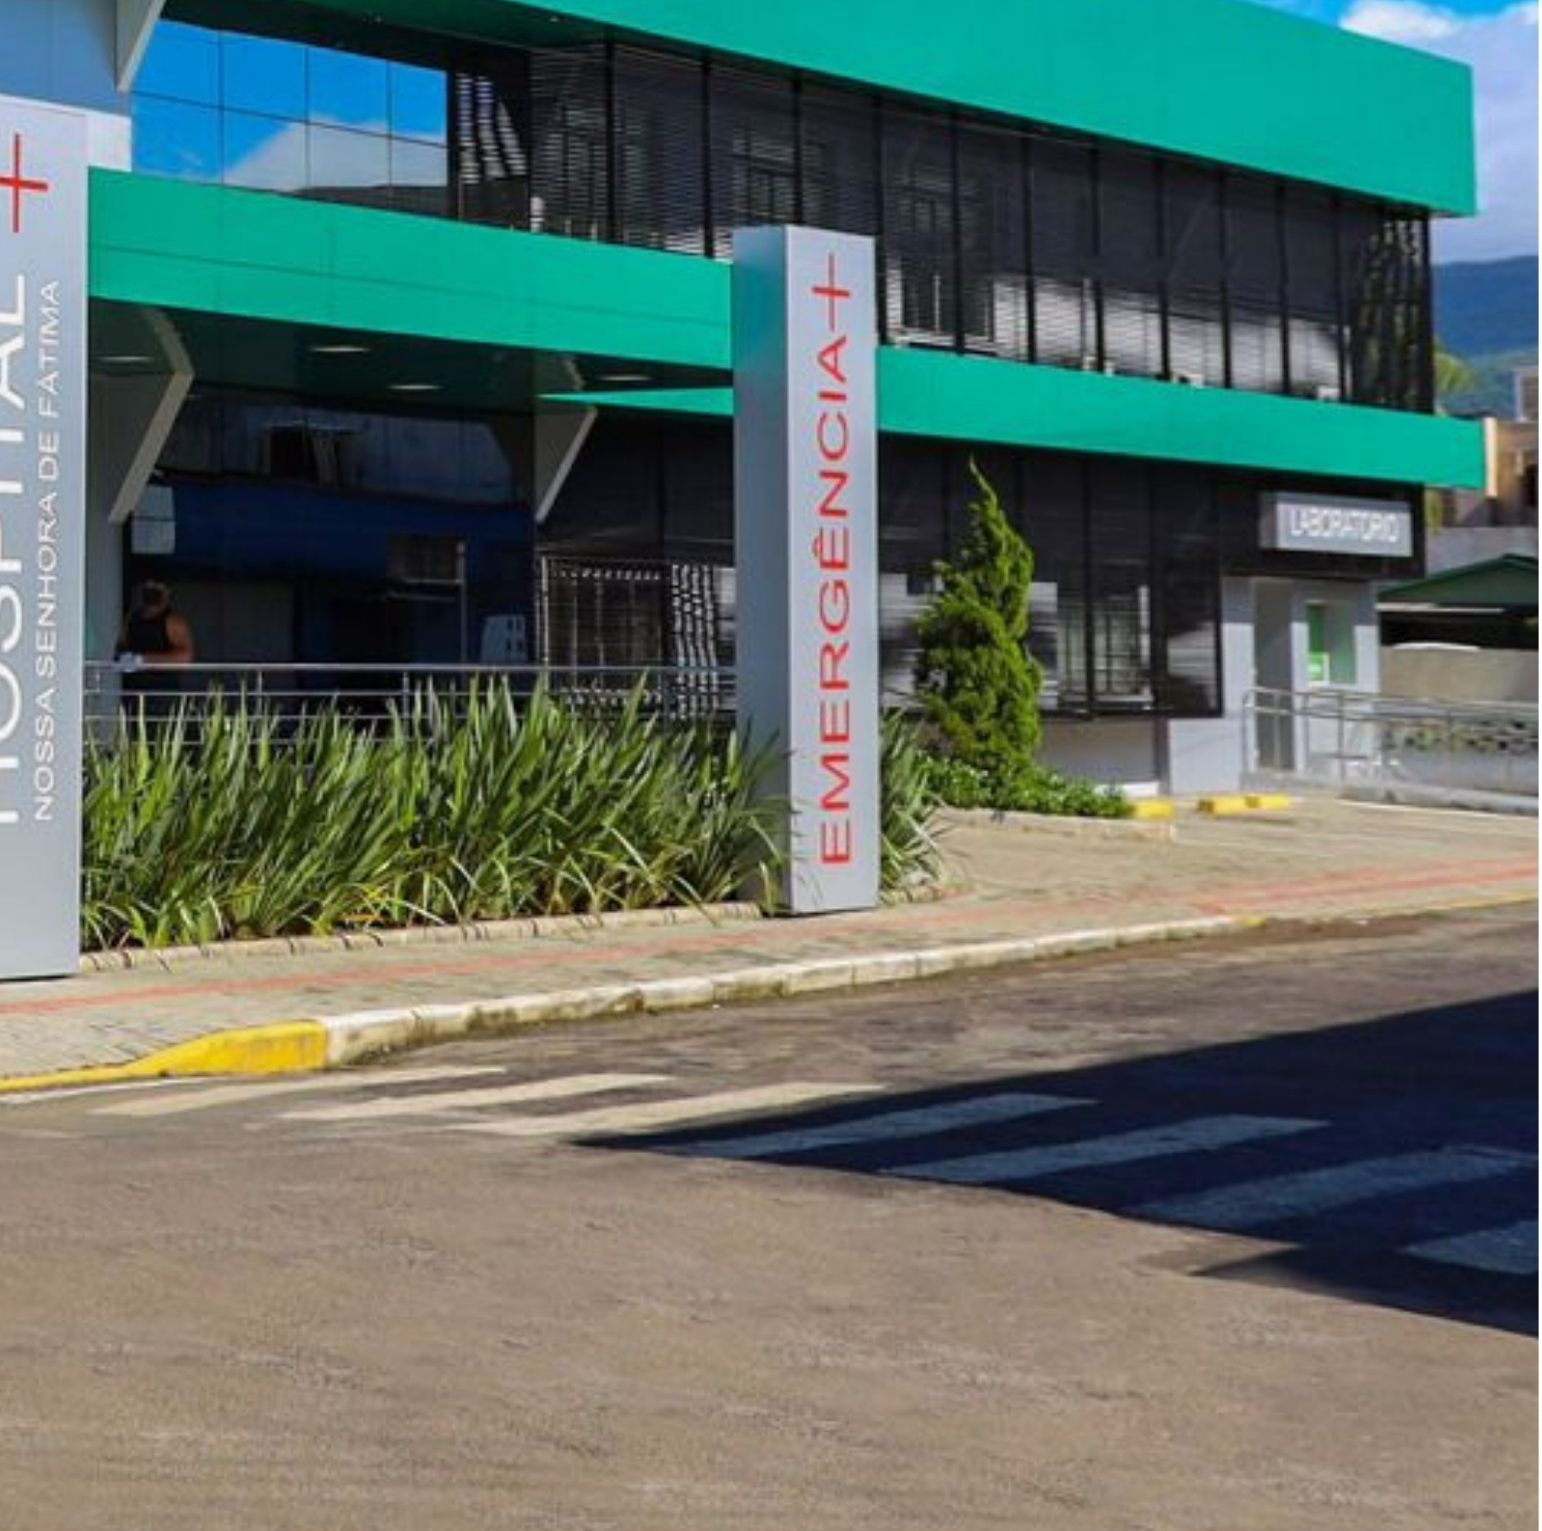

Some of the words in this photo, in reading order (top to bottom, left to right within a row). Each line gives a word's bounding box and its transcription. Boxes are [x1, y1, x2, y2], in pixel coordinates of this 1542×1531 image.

[37, 431, 59, 482] DE
[35, 491, 59, 679] SENHORA
[812, 335, 851, 865] EMERGÊNCIA
[34, 687, 57, 821] NOSSA
